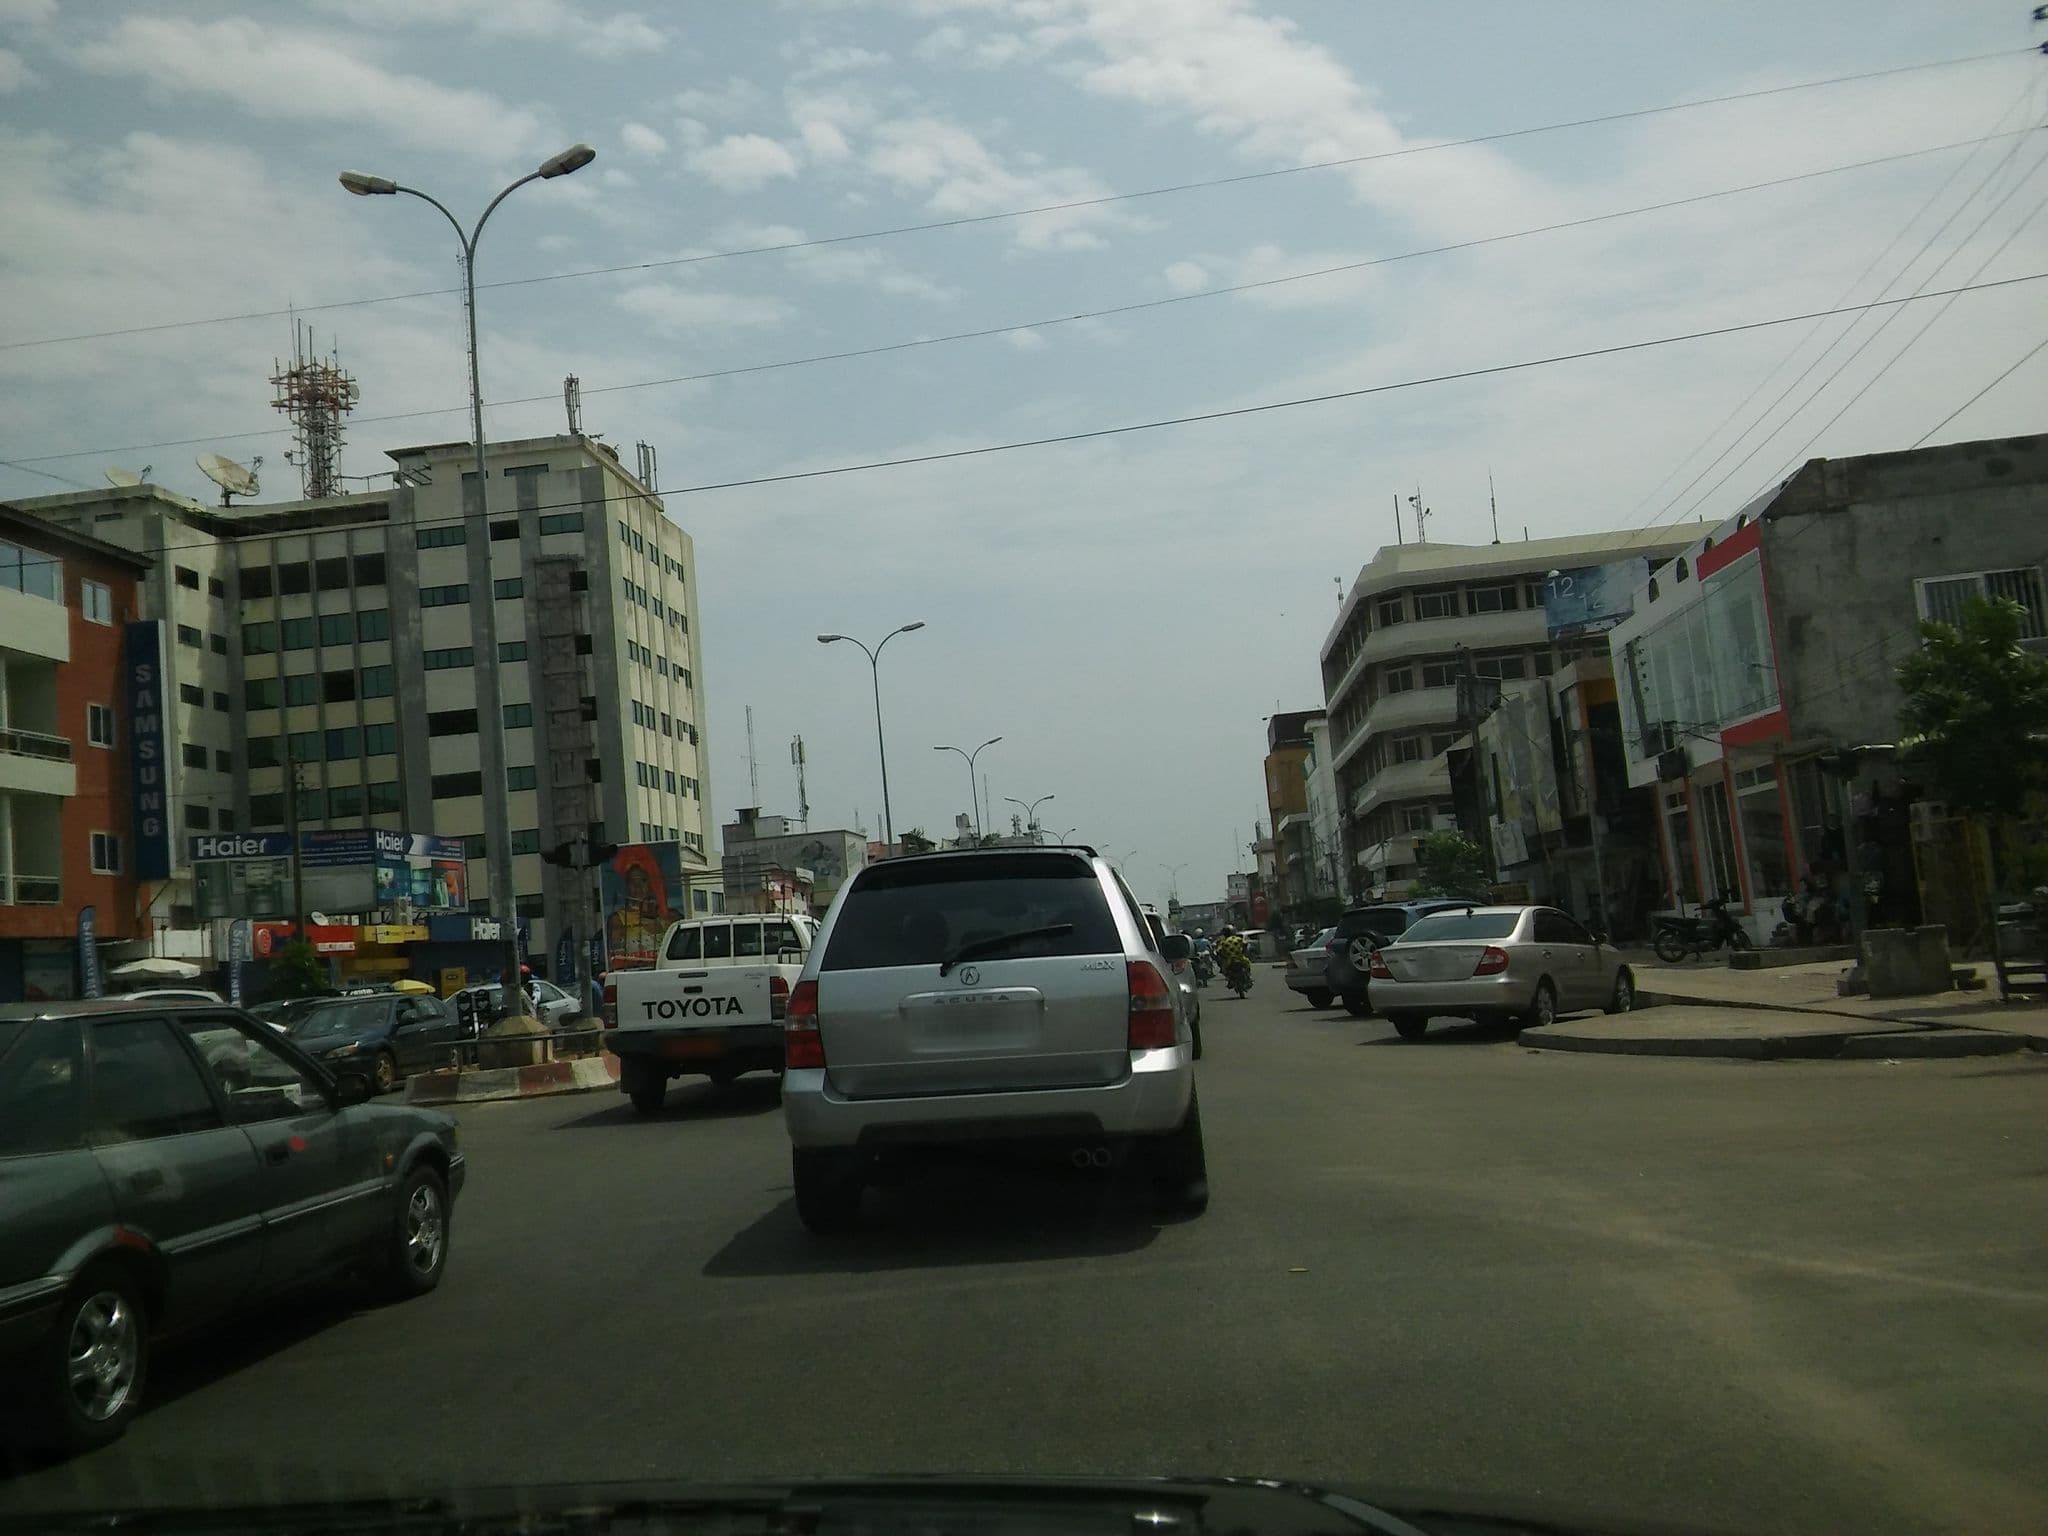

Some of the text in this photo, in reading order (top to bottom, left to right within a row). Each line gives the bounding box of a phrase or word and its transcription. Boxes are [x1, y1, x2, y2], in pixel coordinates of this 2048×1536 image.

[1548, 577, 1575, 599] 12
[134, 664, 161, 838] SAMSUNG
[197, 834, 267, 857] Haier
[375, 831, 405, 852] Haier
[471, 917, 502, 940] Haier
[1080, 959, 1115, 971] MDX
[642, 996, 744, 1020] TOYOTA
[933, 994, 1010, 1005] ACURA
